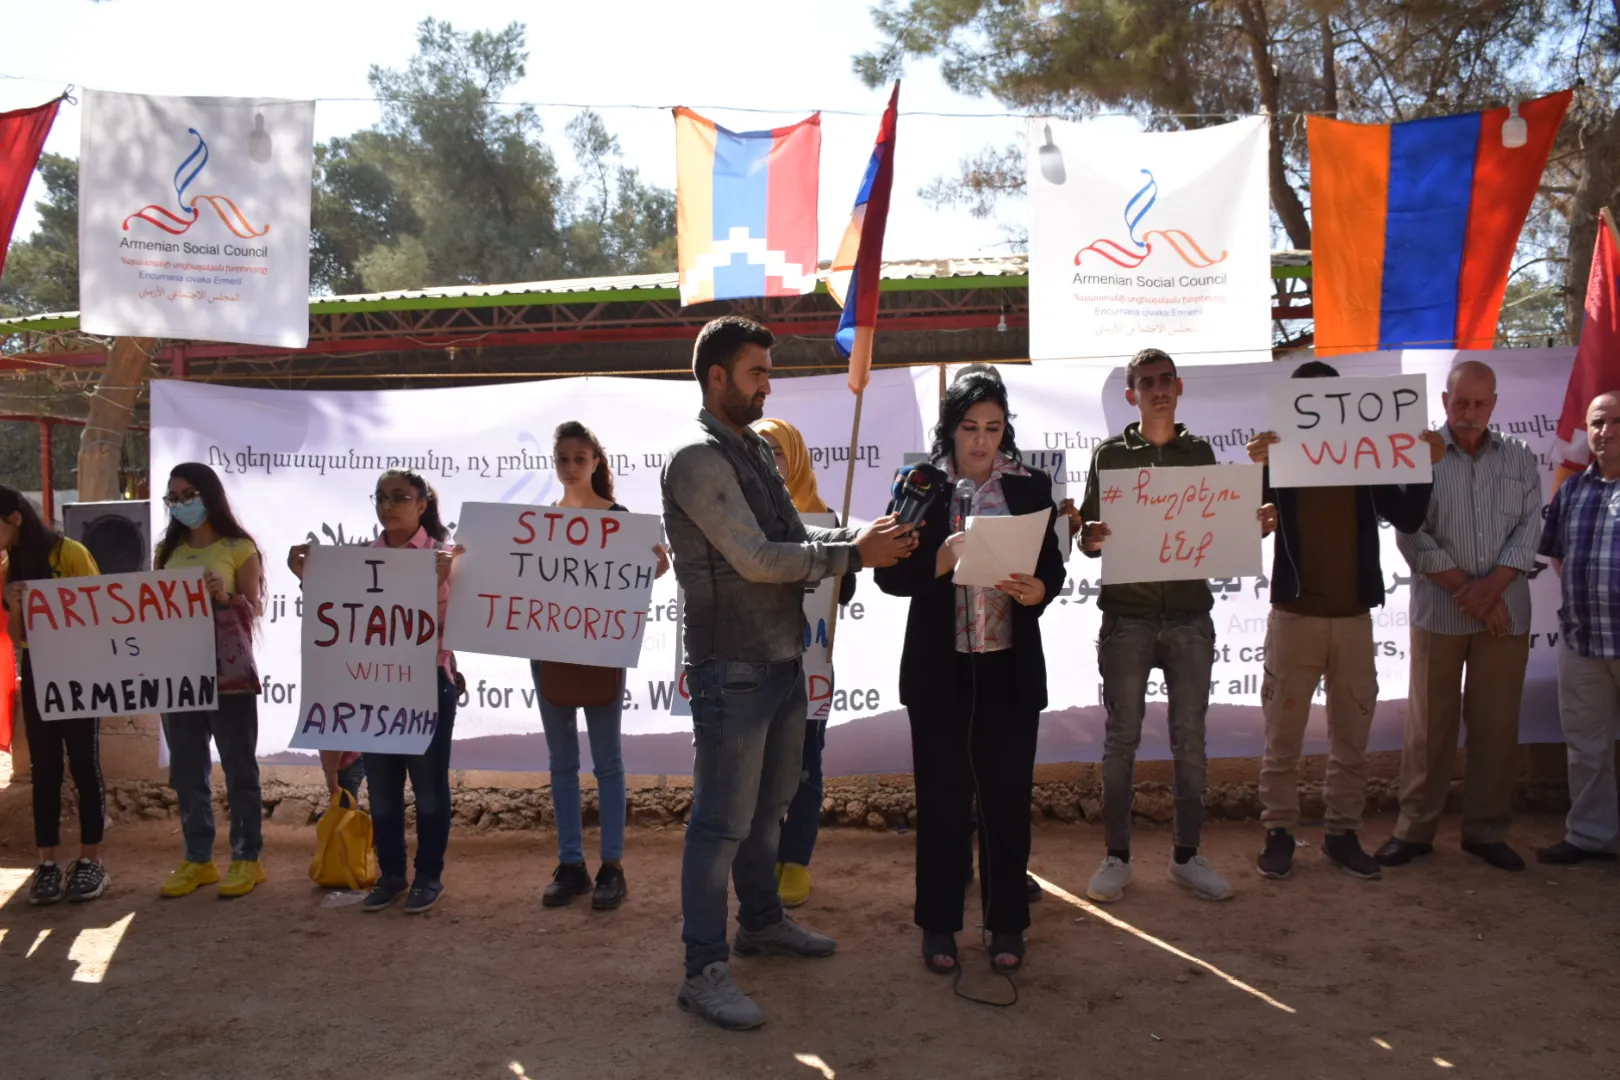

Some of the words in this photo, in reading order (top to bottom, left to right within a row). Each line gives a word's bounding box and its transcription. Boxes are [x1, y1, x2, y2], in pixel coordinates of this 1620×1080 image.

[120, 237, 179, 252] Armenian
[183, 242, 220, 255] Social
[224, 244, 268, 257] Council
[1072, 272, 1132, 287] Armenian
[1136, 275, 1175, 288] Social
[1178, 273, 1227, 288] Council
[1293, 388, 1419, 430] STOP
[1301, 432, 1416, 470] WAR
[513, 511, 620, 549] STOP
[364, 559, 385, 593] I
[510, 552, 652, 590] TURKISH
[27, 578, 209, 631] ARTSAKH
[477, 593, 646, 640] TERRORIST
[314, 602, 435, 648] STAND
[110, 636, 140, 657] IS
[262, 675, 296, 704] for
[346, 661, 411, 683] WITH
[1228, 675, 1257, 695] all
[44, 675, 215, 714] ARMENIAN
[477, 680, 514, 709] for
[302, 702, 437, 737] ARTSAKH
